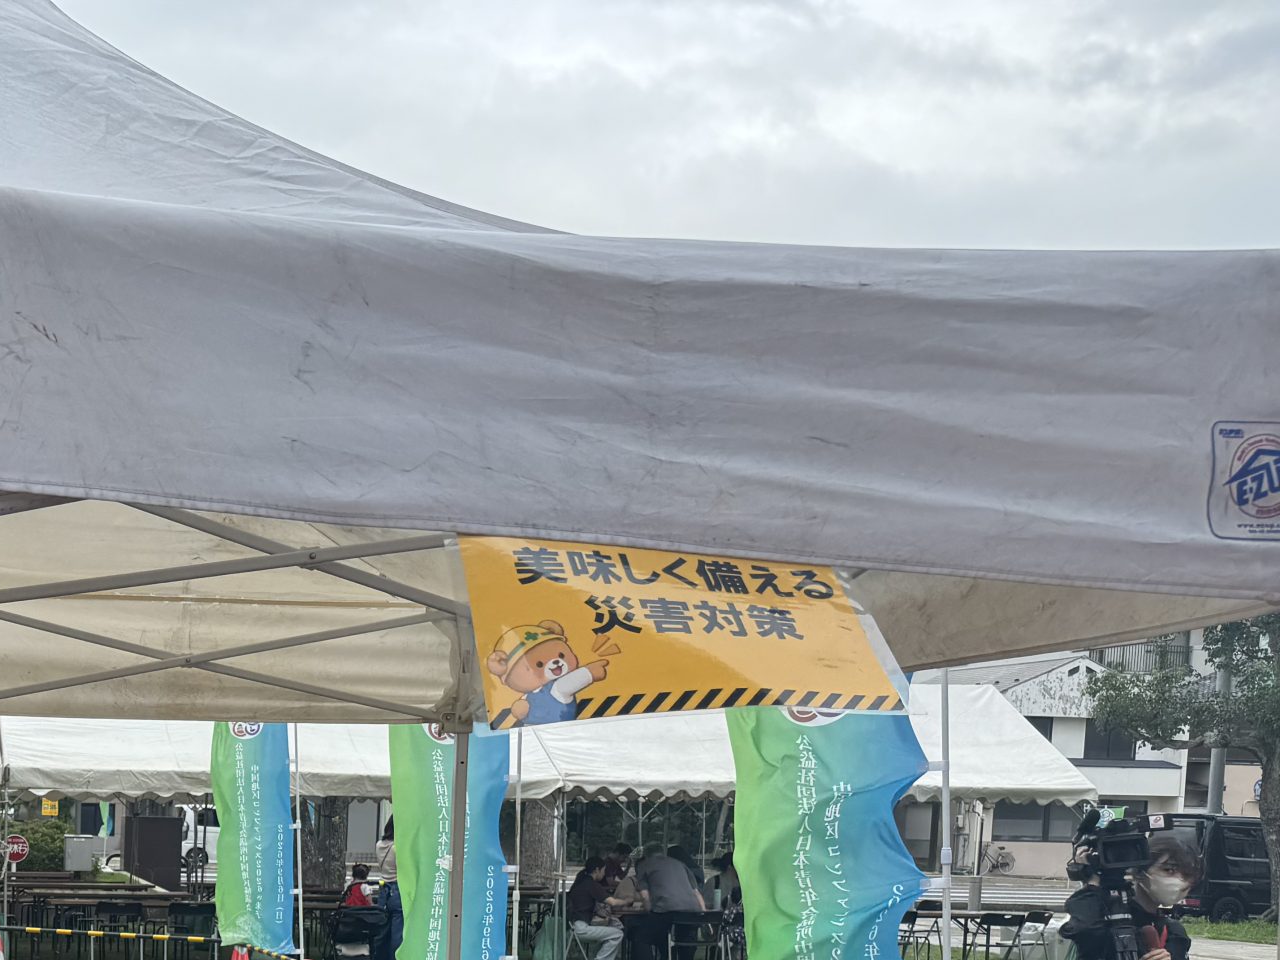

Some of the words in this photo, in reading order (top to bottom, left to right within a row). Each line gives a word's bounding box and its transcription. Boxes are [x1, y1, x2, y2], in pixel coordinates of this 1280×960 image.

[513, 547, 834, 600] 美味しく備える
[584, 594, 805, 641] 災害対策
